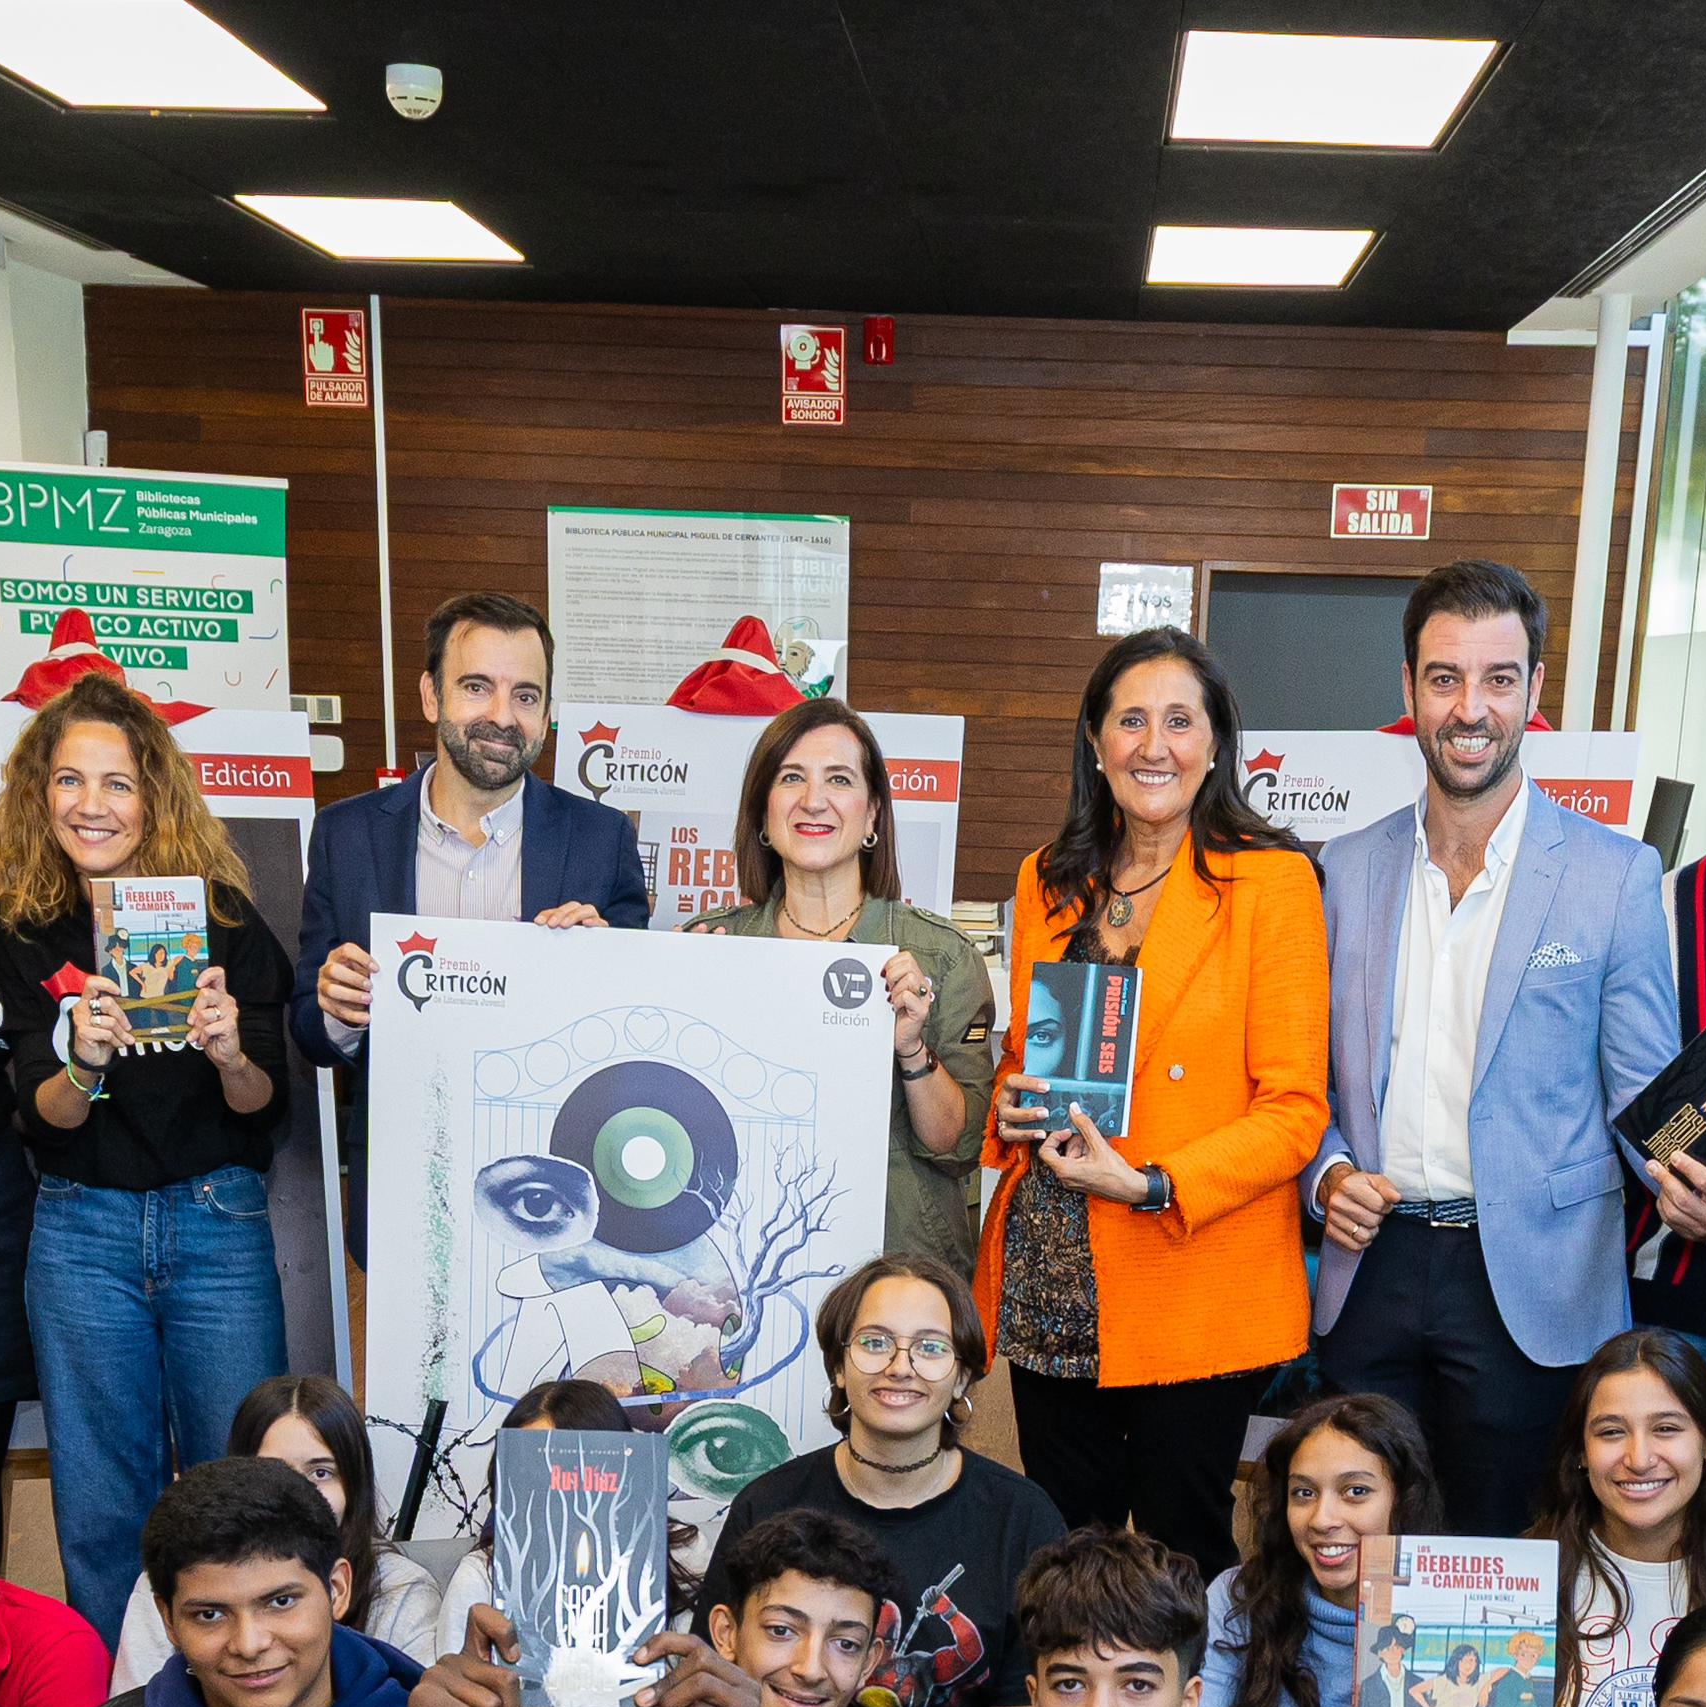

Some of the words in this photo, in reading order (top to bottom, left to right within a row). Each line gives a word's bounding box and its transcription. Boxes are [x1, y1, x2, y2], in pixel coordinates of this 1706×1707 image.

[309, 380, 363, 396] PULSADOR
[309, 390, 323, 402] DE
[323, 391, 364, 403] ALARMA
[786, 398, 840, 411] AVISADOR
[790, 409, 836, 422] SONORO
[136, 490, 201, 506] Bibliotecas
[1365, 490, 1399, 512] SIN
[137, 506, 188, 521] Públicas
[189, 511, 258, 527] Municipales
[1347, 511, 1415, 536] SALIDA
[138, 522, 193, 538] Zaragoza
[565, 526, 611, 537] BIBLIOTECA
[612, 528, 645, 538] PÚBLICA
[646, 530, 689, 539] MUNICIPAL
[691, 531, 720, 540] MIGUEL
[722, 533, 733, 541] DE
[2, 581, 89, 603] SOMOS
[95, 586, 129, 606] UN
[136, 589, 244, 611] SERVICIO
[30, 612, 132, 635] PÚICO
[138, 619, 222, 639] ACTIVO
[113, 647, 173, 667] VIVO.
[621, 745, 662, 761] Premio
[200, 762, 291, 789] Edición
[578, 742, 689, 802] CRITICÓN
[1283, 773, 1325, 789] Premio
[671, 826, 698, 844] LOS
[125, 890, 175, 902] REBELDES
[135, 902, 170, 912] CAMDEN
[172, 901, 197, 911] TOWN
[438, 956, 481, 973] Premio
[397, 953, 508, 1014] CRITICÓN
[1102, 975, 1123, 1038] PRISIÓN
[821, 1010, 871, 1028] Edición
[1098, 1041, 1116, 1074] SEIS
[550, 1465, 580, 1491] Rui
[1417, 1545, 1431, 1553] LOS
[1417, 1555, 1504, 1574] REBELDES
[1433, 1574, 1493, 1591] CAMDEN
[1496, 1576, 1540, 1592] TOWN
